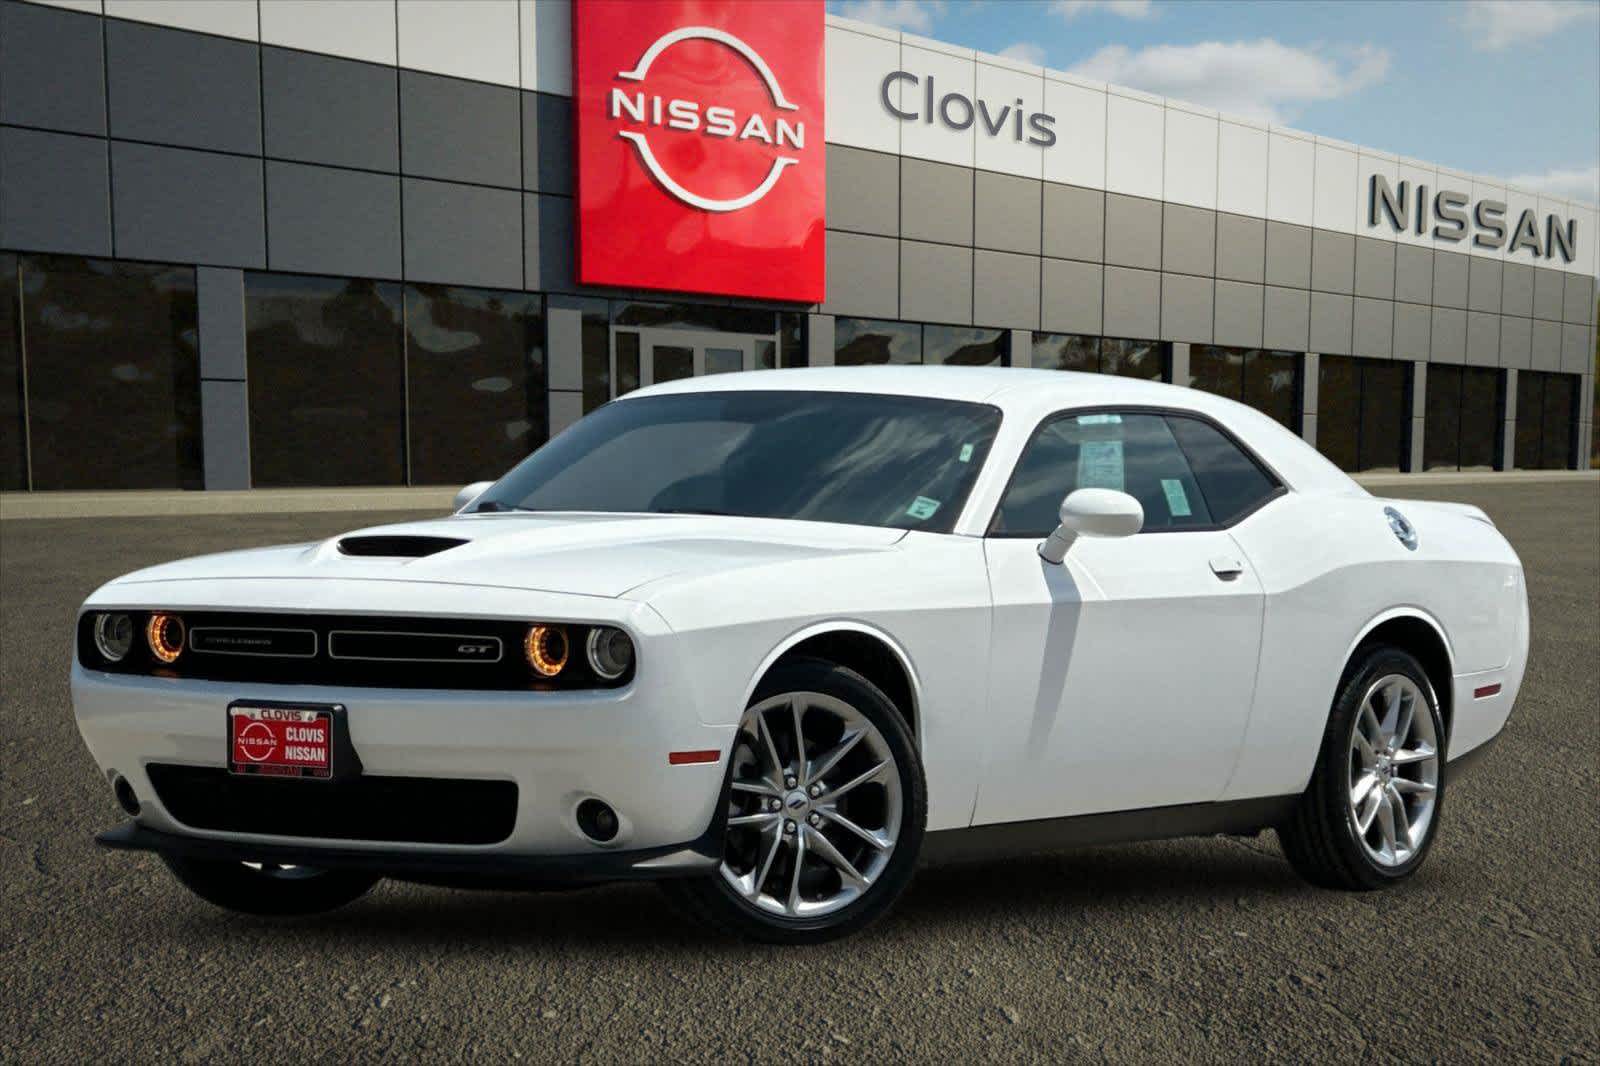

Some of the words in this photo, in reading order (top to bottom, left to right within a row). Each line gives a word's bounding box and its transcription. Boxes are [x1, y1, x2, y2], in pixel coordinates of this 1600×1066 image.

[881, 70, 1057, 147] Clovis
[611, 87, 805, 149] NISSAN
[1369, 173, 1577, 263] NISSAN
[260, 709, 302, 721] CLOVIS
[237, 737, 278, 746] NISSAN
[285, 726, 325, 743] CLOVIS
[284, 745, 326, 762] NISSAN
